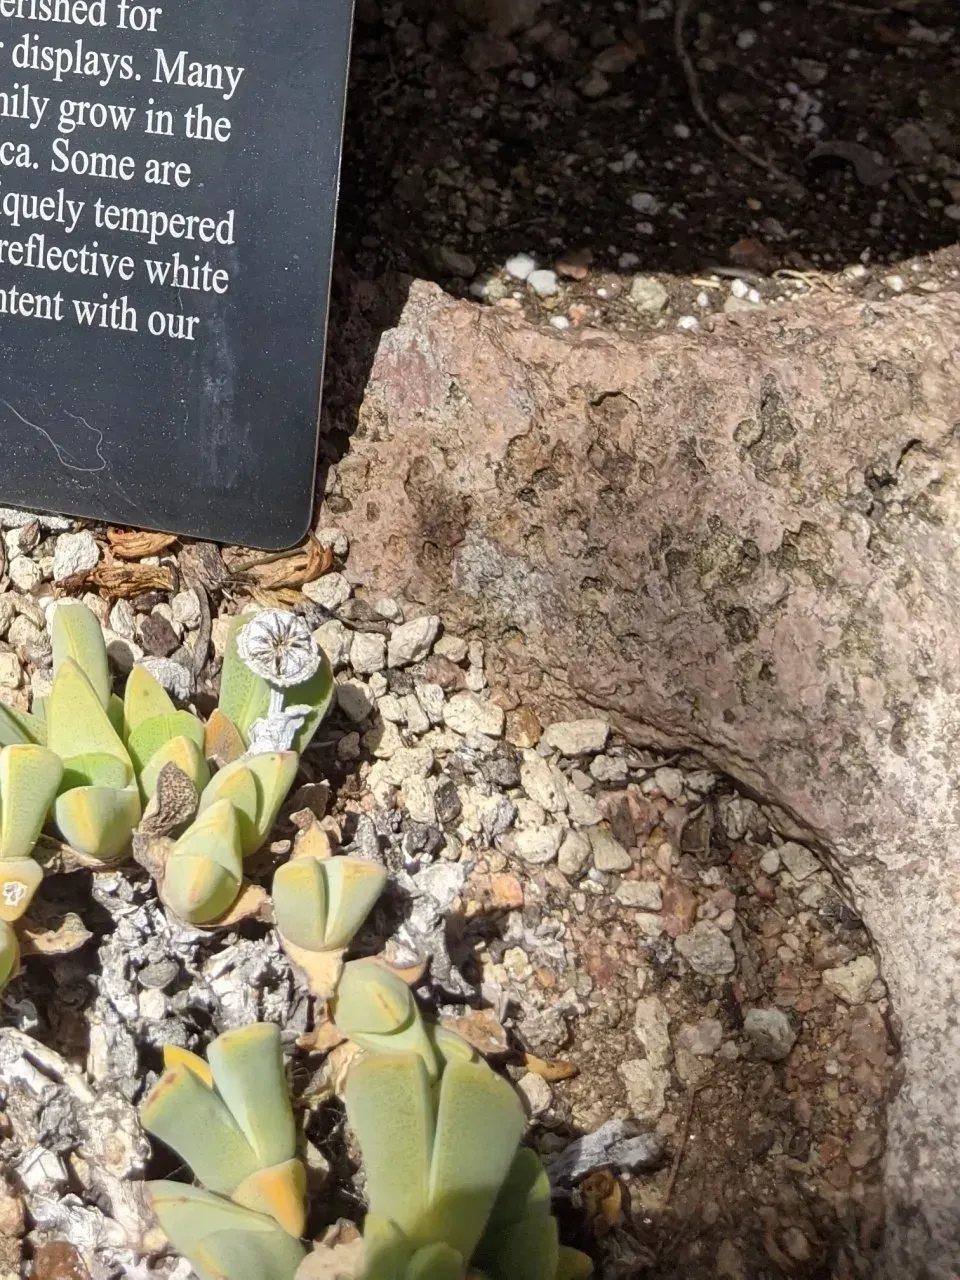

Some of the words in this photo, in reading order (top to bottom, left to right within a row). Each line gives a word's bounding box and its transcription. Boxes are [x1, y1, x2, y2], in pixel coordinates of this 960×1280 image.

[11, 33, 142, 87] displays.
[151, 47, 245, 101] Many
[57, 99, 137, 134] grow
[144, 97, 175, 136] in
[183, 103, 232, 143] the
[50, 137, 136, 181] Some
[144, 159, 192, 188] are
[93, 197, 236, 246] tempered
[143, 251, 229, 294] white
[71, 292, 139, 333] with
[147, 310, 201, 341] our
